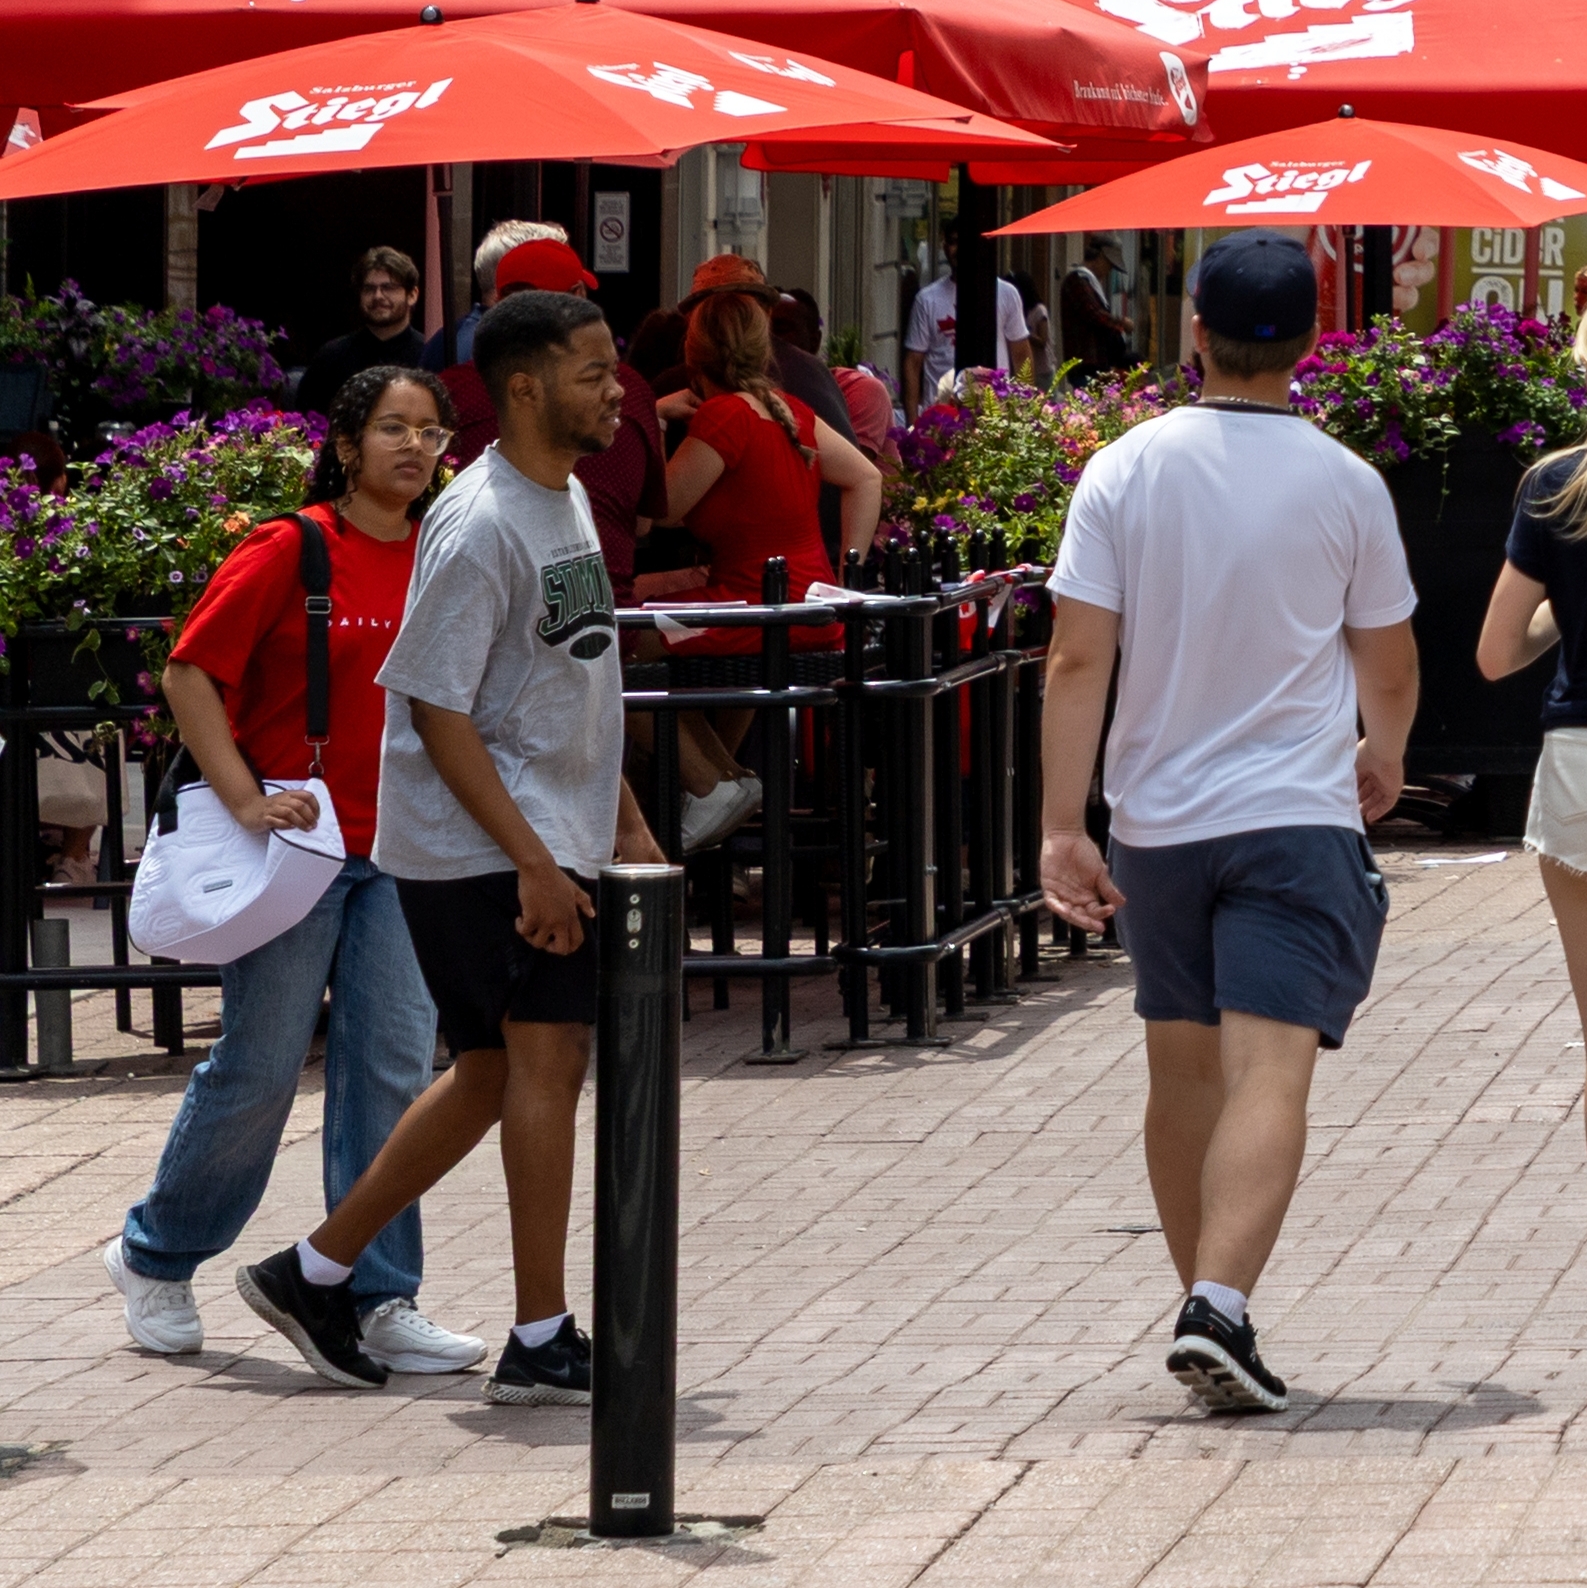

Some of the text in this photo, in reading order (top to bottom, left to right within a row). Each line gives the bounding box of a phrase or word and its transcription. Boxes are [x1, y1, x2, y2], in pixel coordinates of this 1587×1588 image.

[309, 80, 417, 95] Salzburger
[204, 78, 454, 151] Stiegl
[1203, 160, 1373, 206] Stiegl
